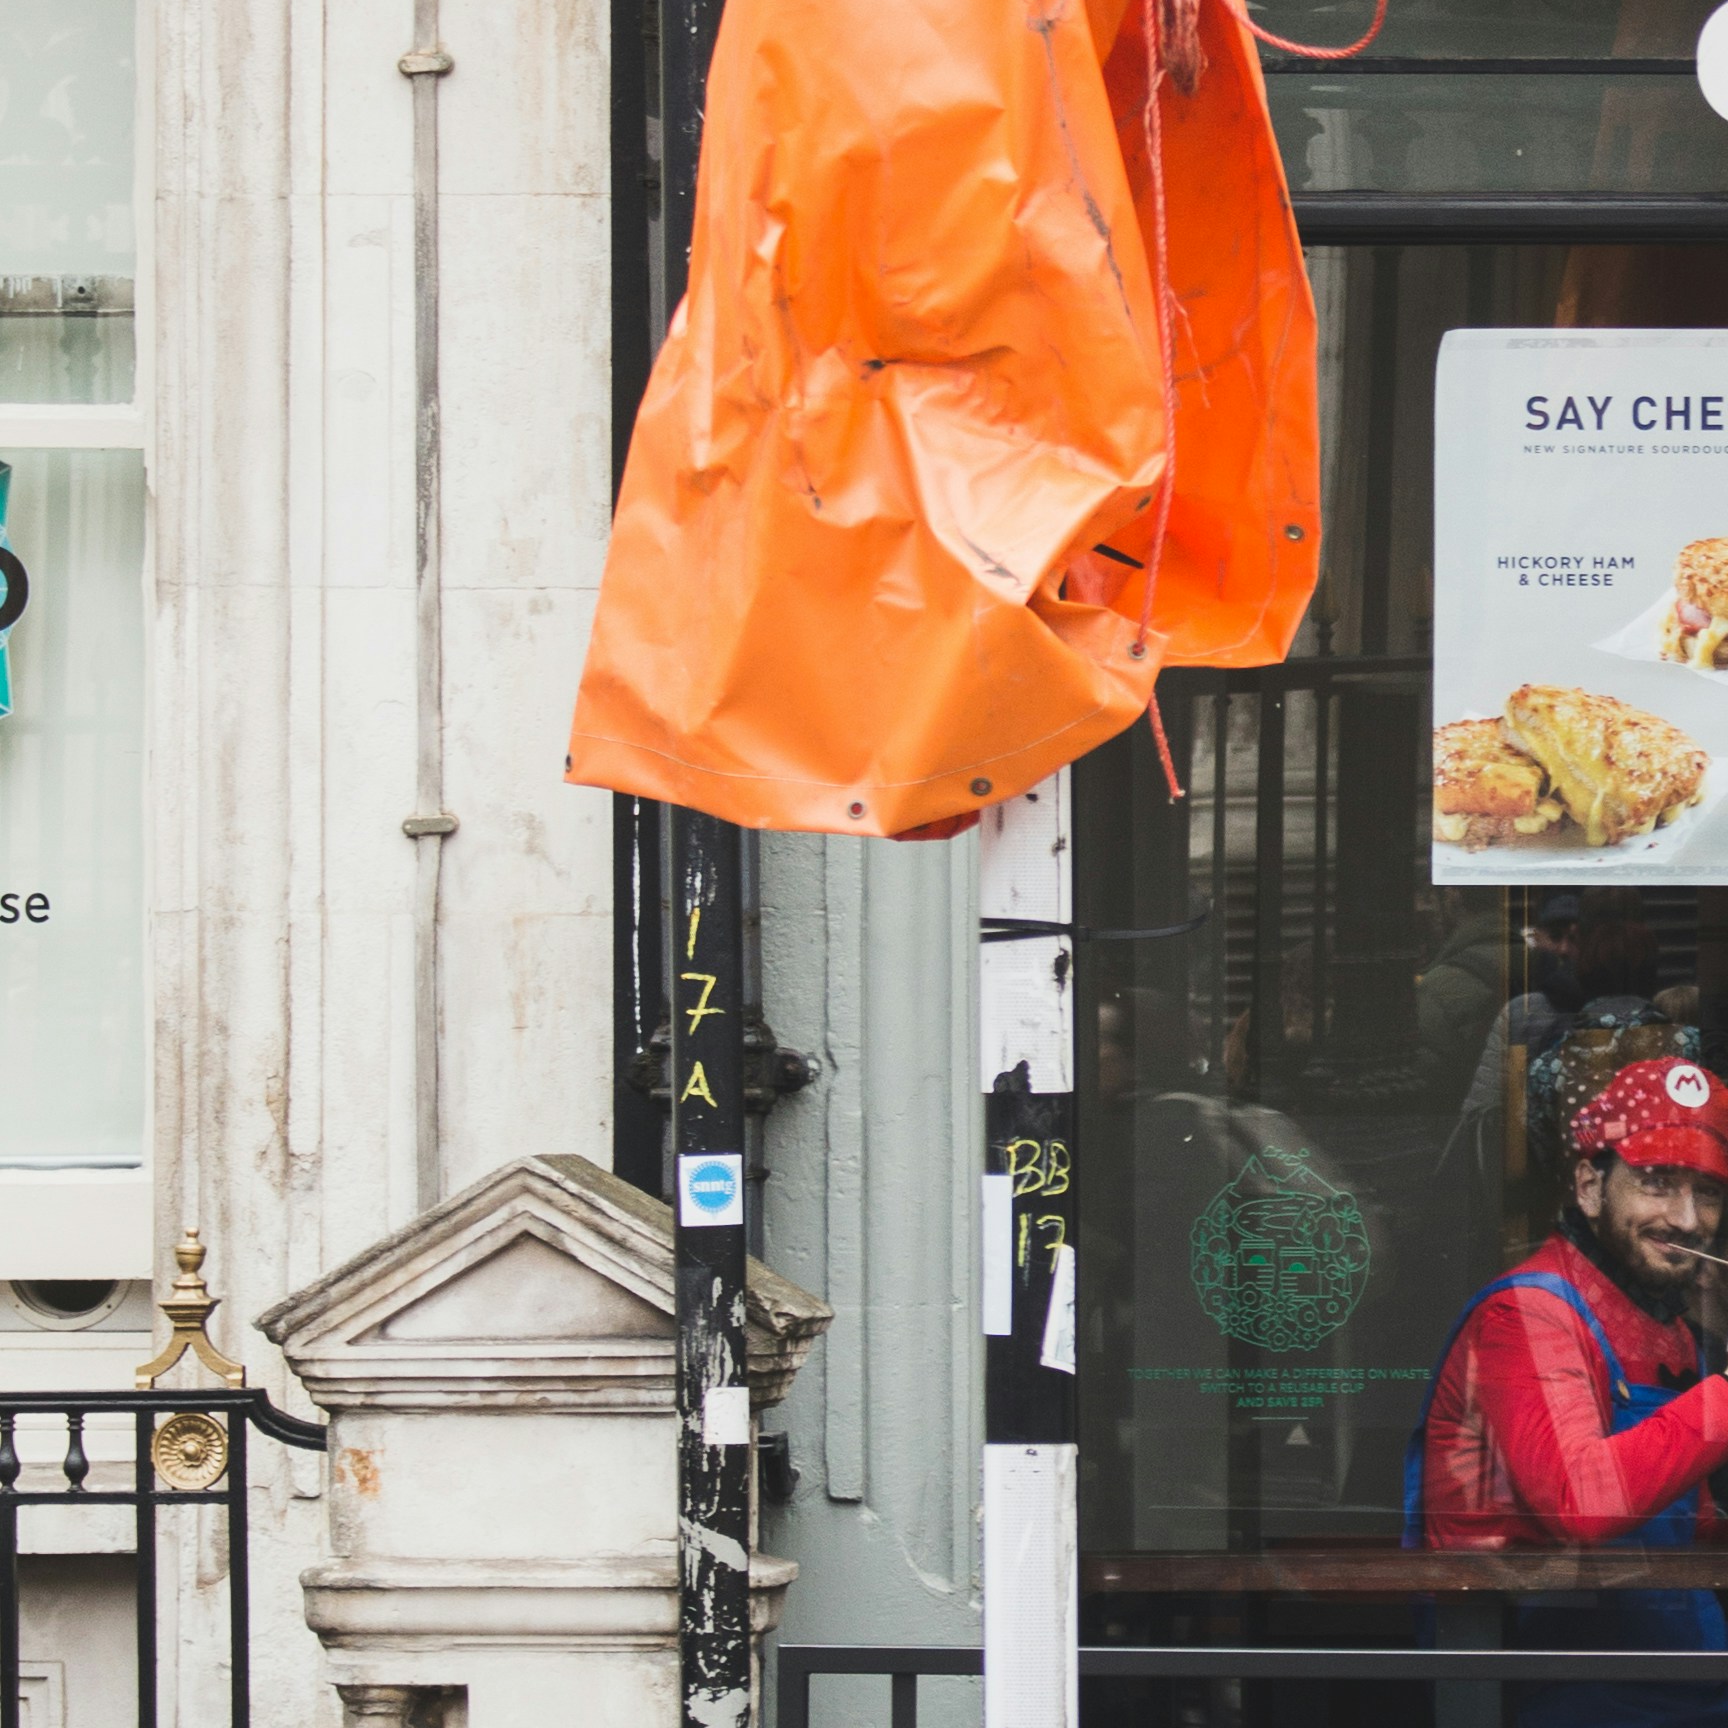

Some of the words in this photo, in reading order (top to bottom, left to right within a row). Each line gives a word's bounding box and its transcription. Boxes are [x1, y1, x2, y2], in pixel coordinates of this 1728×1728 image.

[1525, 395, 1613, 431] SAY
[1523, 444, 1554, 454] NEW
[1562, 444, 1644, 455] SIGNATURE
[1497, 556, 1584, 570] HICKORY
[1593, 556, 1635, 569] HAM
[1518, 573, 1529, 586] &
[1538, 573, 1613, 587] CHEESE
[1674, 1073, 1702, 1092] M
[1244, 1368, 1279, 1379] MAKE
[1292, 1368, 1365, 1379] DIFFERENCE
[1368, 1368, 1387, 1379] ON
[1248, 1382, 1265, 1393] TO
[1280, 1382, 1338, 1393] REUSABLE
[1340, 1382, 1365, 1393] CUP
[1236, 1396, 1264, 1408] AND
[1266, 1396, 1298, 1408] SAVE
